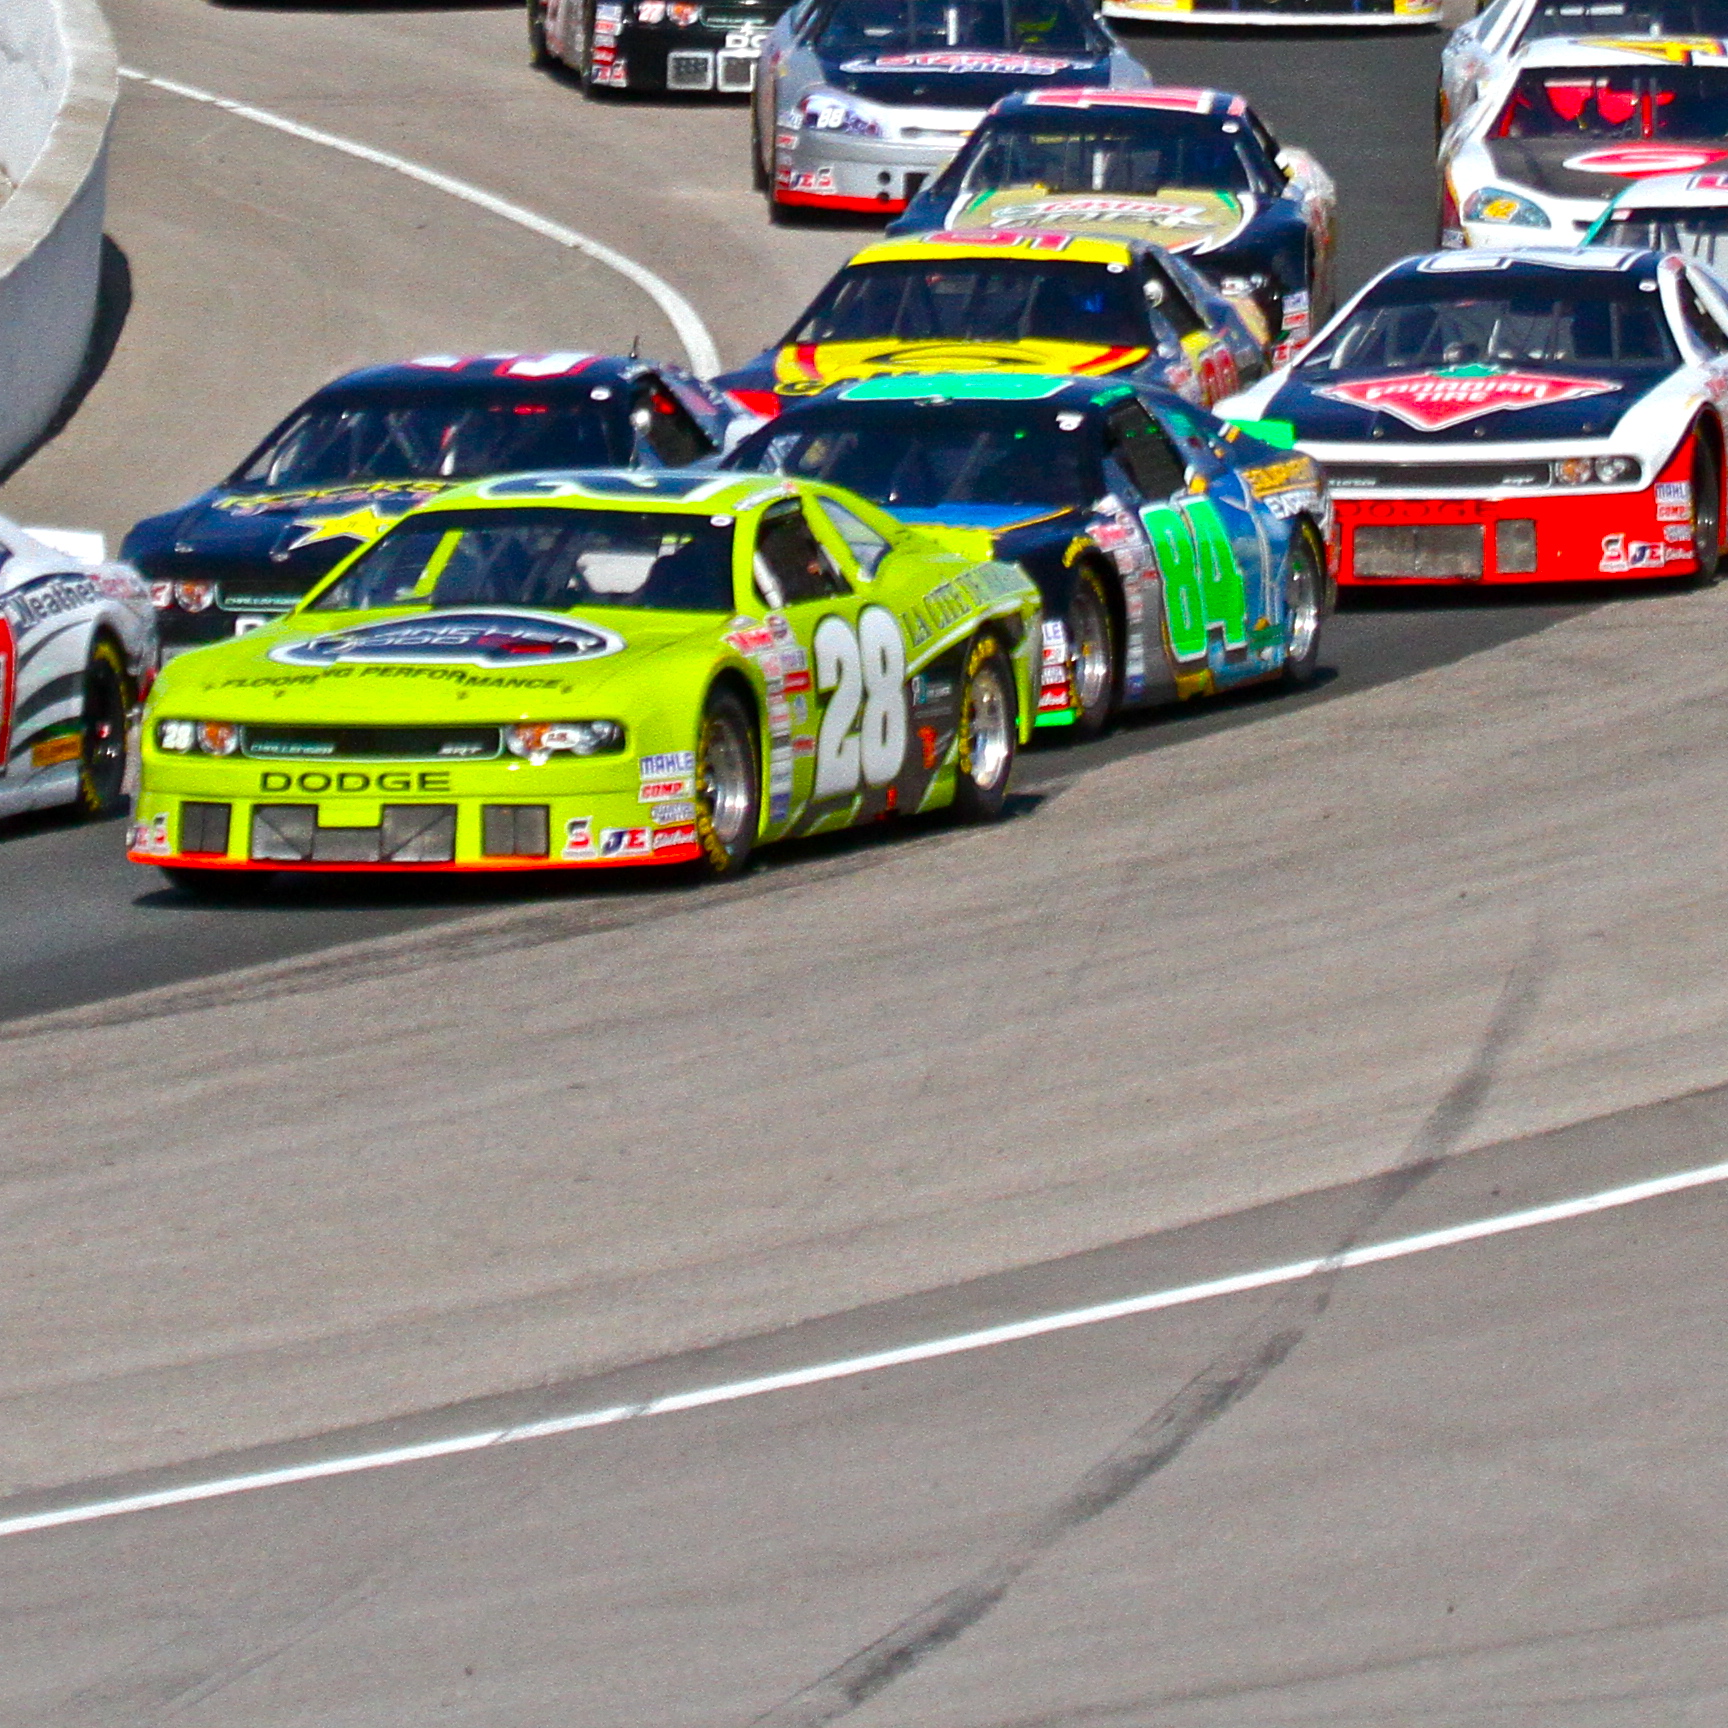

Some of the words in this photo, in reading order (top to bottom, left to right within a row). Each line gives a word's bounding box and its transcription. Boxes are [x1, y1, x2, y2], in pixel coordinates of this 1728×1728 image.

[639, 5, 664, 22] 27
[817, 109, 845, 127] 88
[220, 665, 351, 690] FLOORING
[359, 665, 565, 690] PERFORMANCE
[814, 608, 907, 798] 28
[641, 753, 693, 775] MAHLE
[260, 771, 451, 793] DODGE
